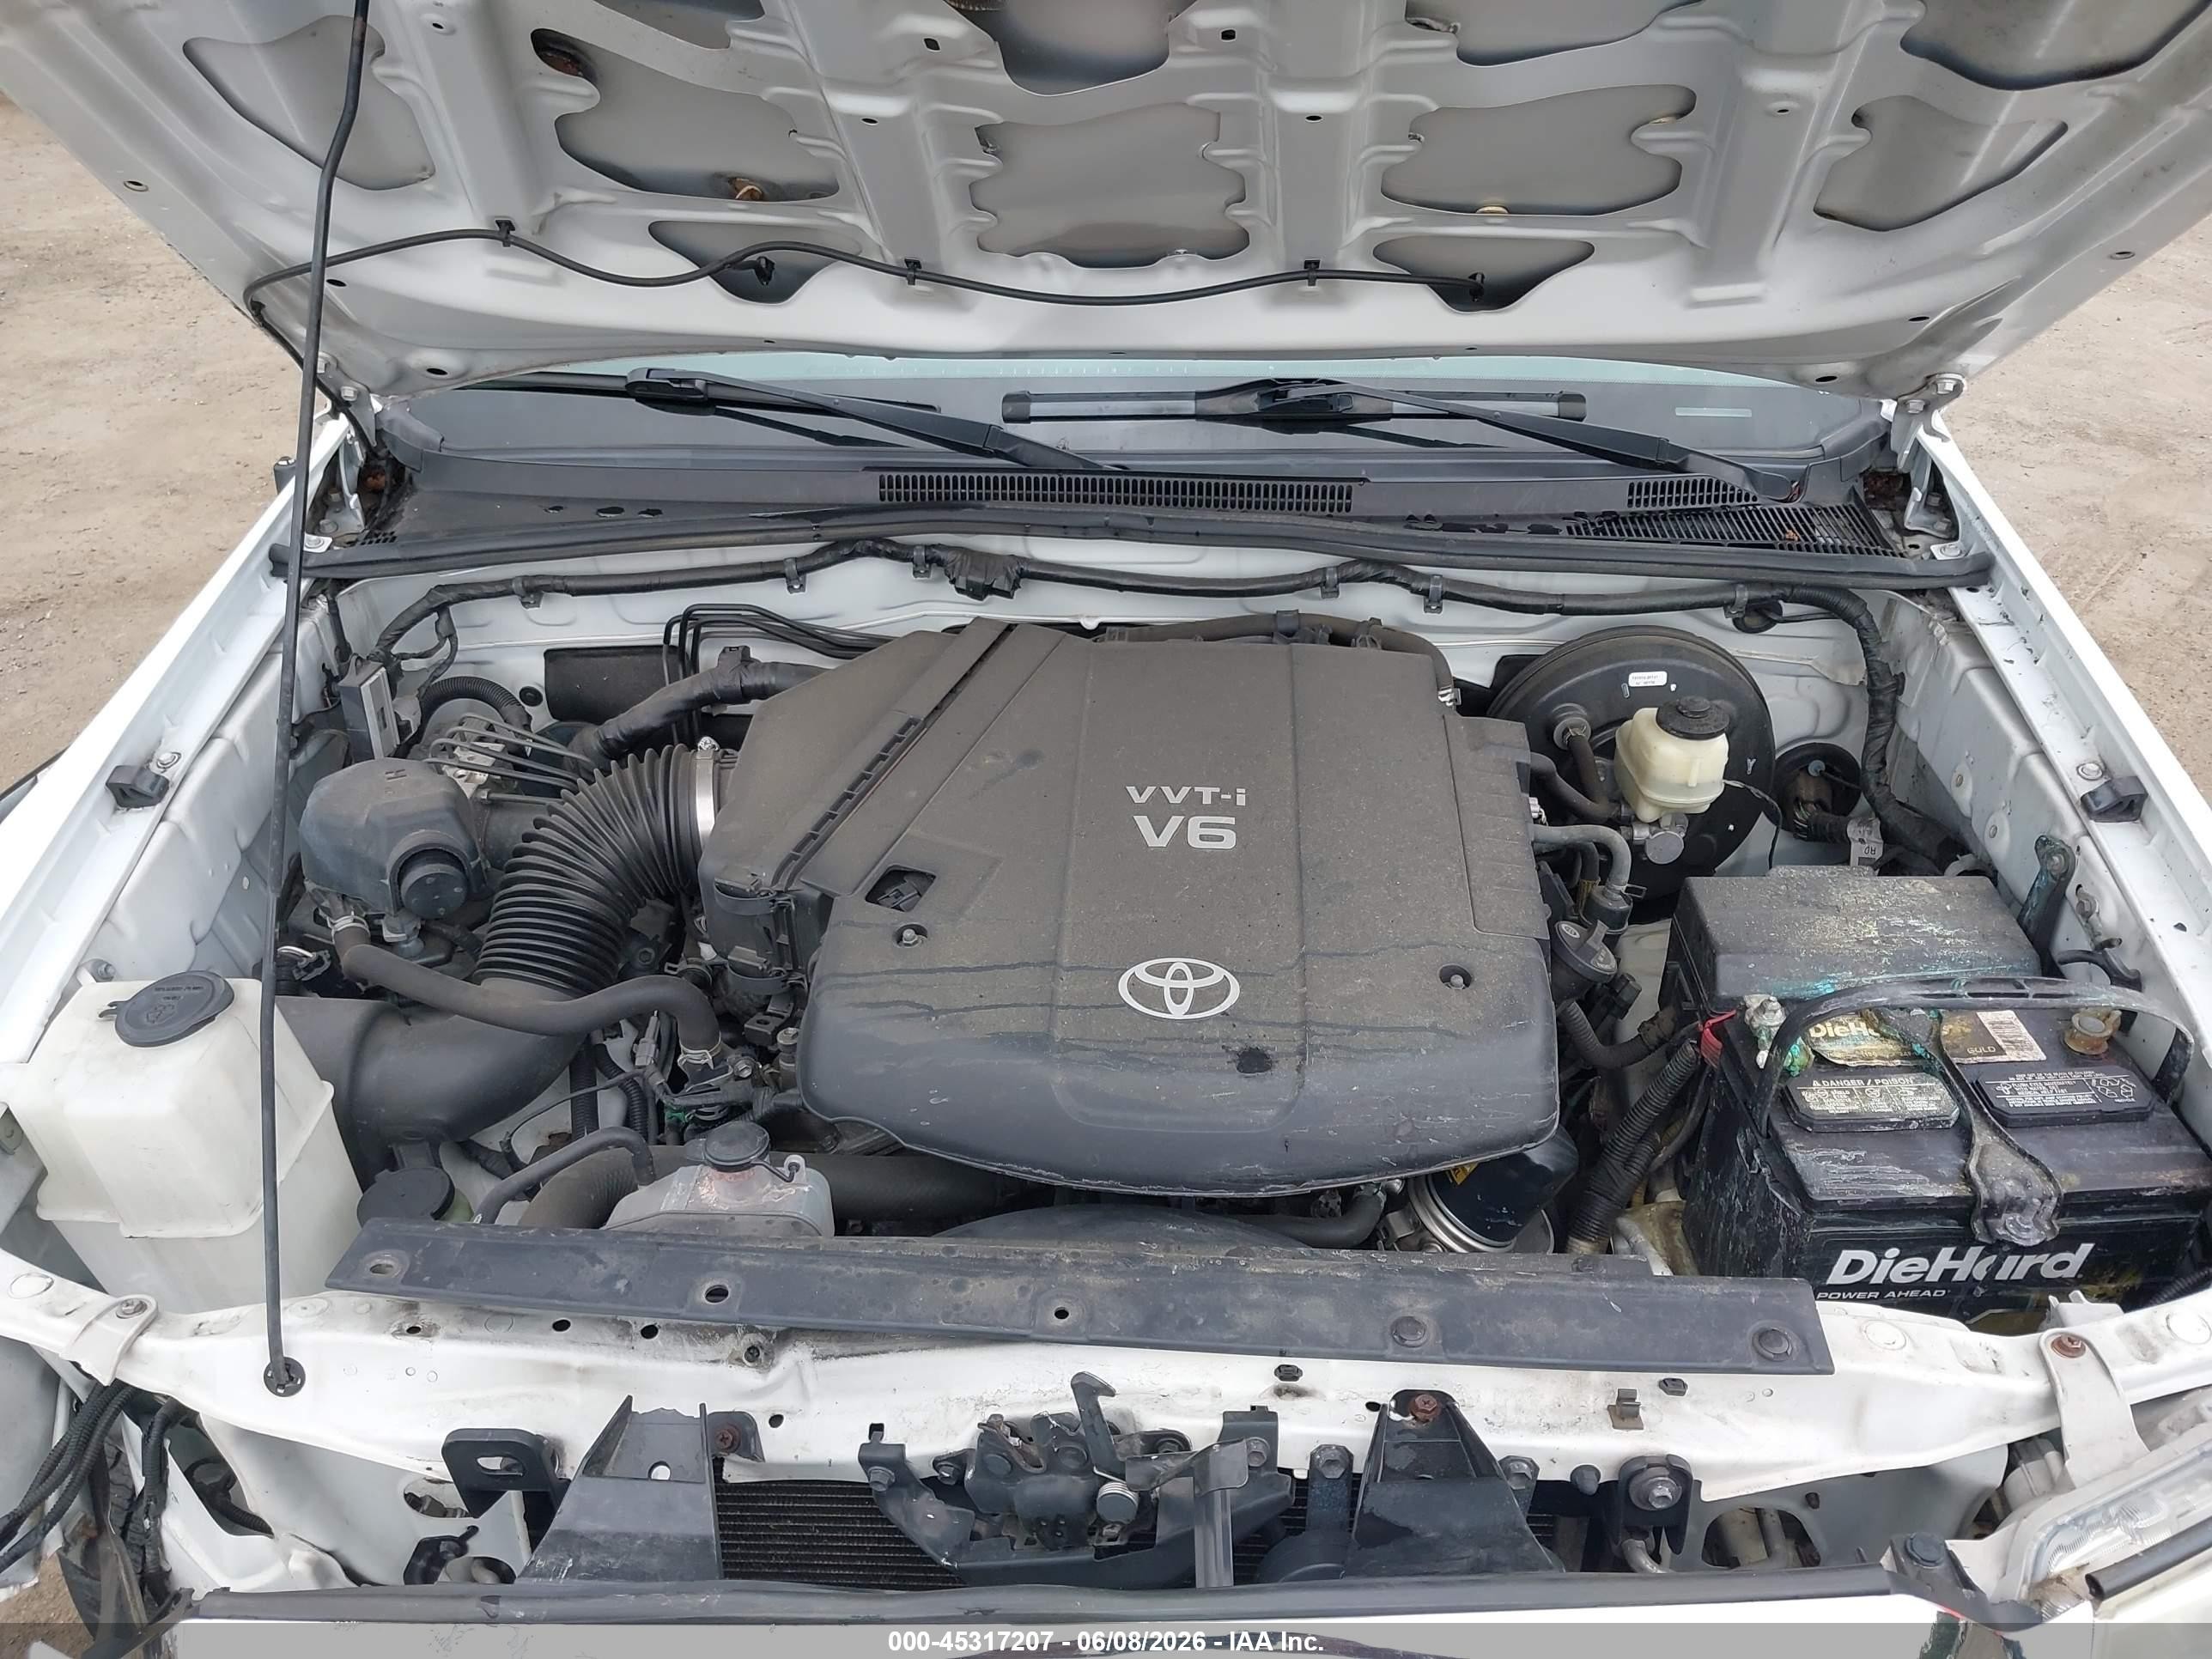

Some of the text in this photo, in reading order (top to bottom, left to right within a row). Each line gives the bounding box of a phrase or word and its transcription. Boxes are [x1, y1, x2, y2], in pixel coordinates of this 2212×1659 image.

[1125, 786, 1246, 806] VVT-i
[1132, 815, 1237, 850] V6
[1821, 1079, 1865, 1087] DANGER
[1875, 1077, 1914, 1086] POISON
[1826, 1243, 2096, 1285] DieHard
[1816, 1289, 1947, 1299] POWER AHEAD
